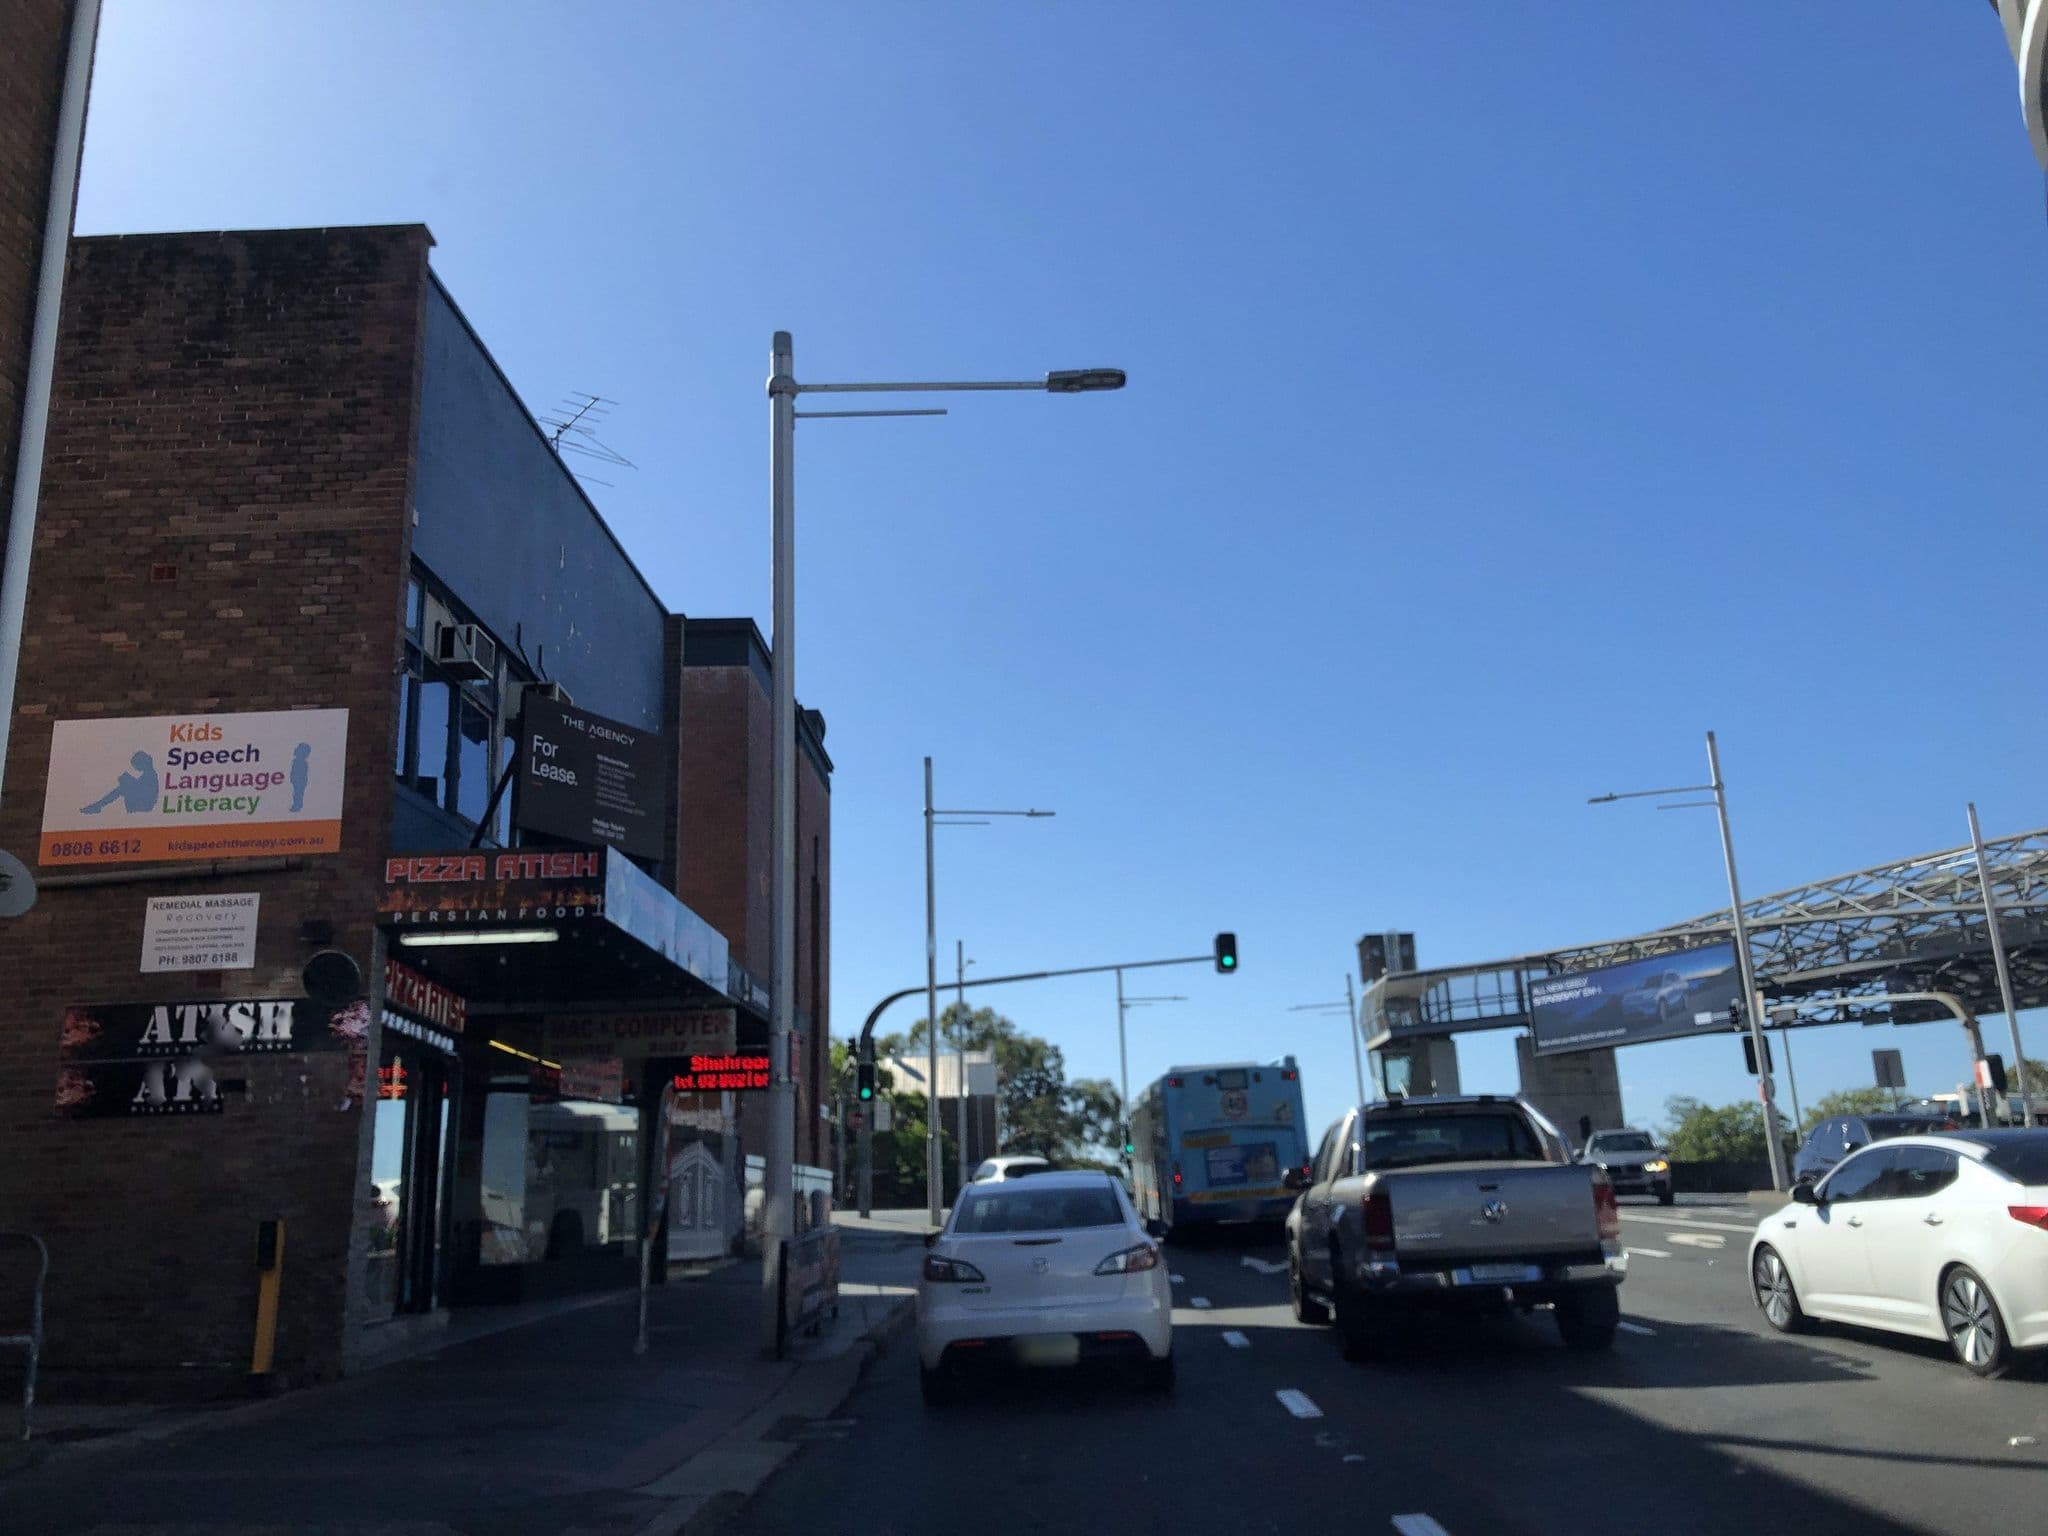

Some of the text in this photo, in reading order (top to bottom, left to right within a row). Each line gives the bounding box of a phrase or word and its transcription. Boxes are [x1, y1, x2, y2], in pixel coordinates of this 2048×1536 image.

[169, 722, 223, 743] Kids
[562, 714, 635, 747] THE AGENCY
[167, 743, 260, 771] Speech
[533, 734, 559, 758] For
[165, 771, 285, 793] Language
[532, 756, 578, 786] Lease.
[162, 795, 260, 815] Literacy
[98, 839, 142, 854] 6612
[386, 852, 598, 883] PIZZA ATISH
[152, 897, 255, 911] REMEDIAL MASSAGE
[394, 906, 585, 923] PERSIAN FOOD
